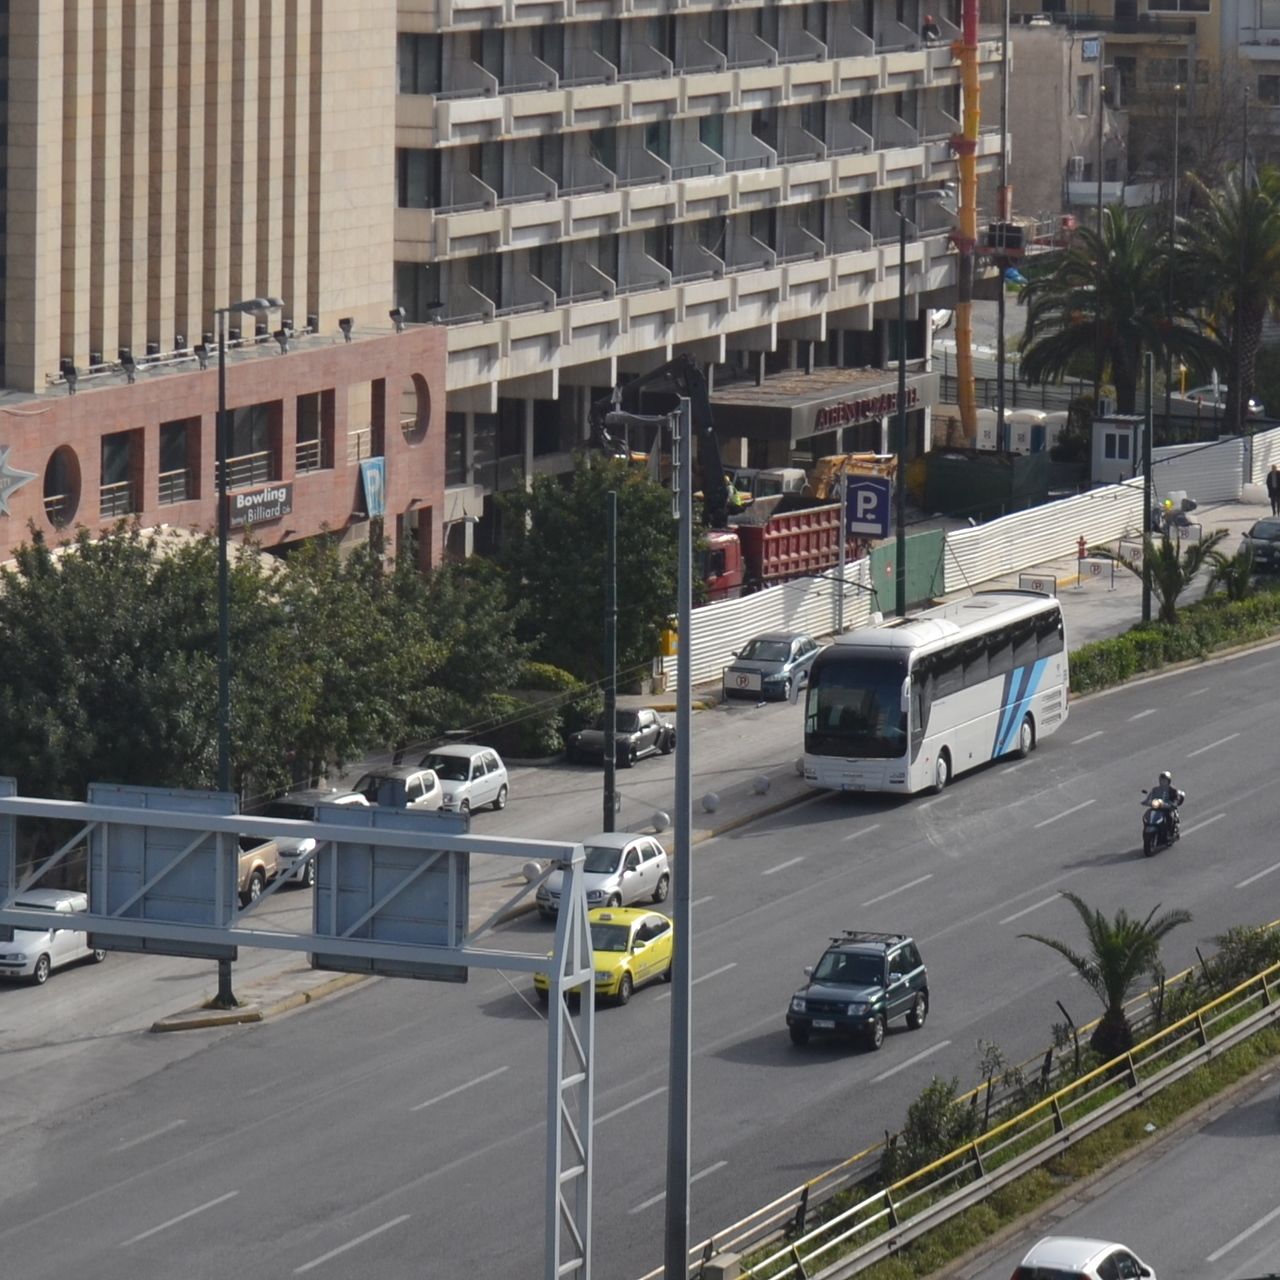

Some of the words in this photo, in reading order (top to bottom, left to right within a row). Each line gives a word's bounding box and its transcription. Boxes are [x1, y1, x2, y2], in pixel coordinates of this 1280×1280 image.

[236, 488, 286, 509] Bowling
[857, 490, 878, 518] P
[247, 501, 281, 522] Billiard
